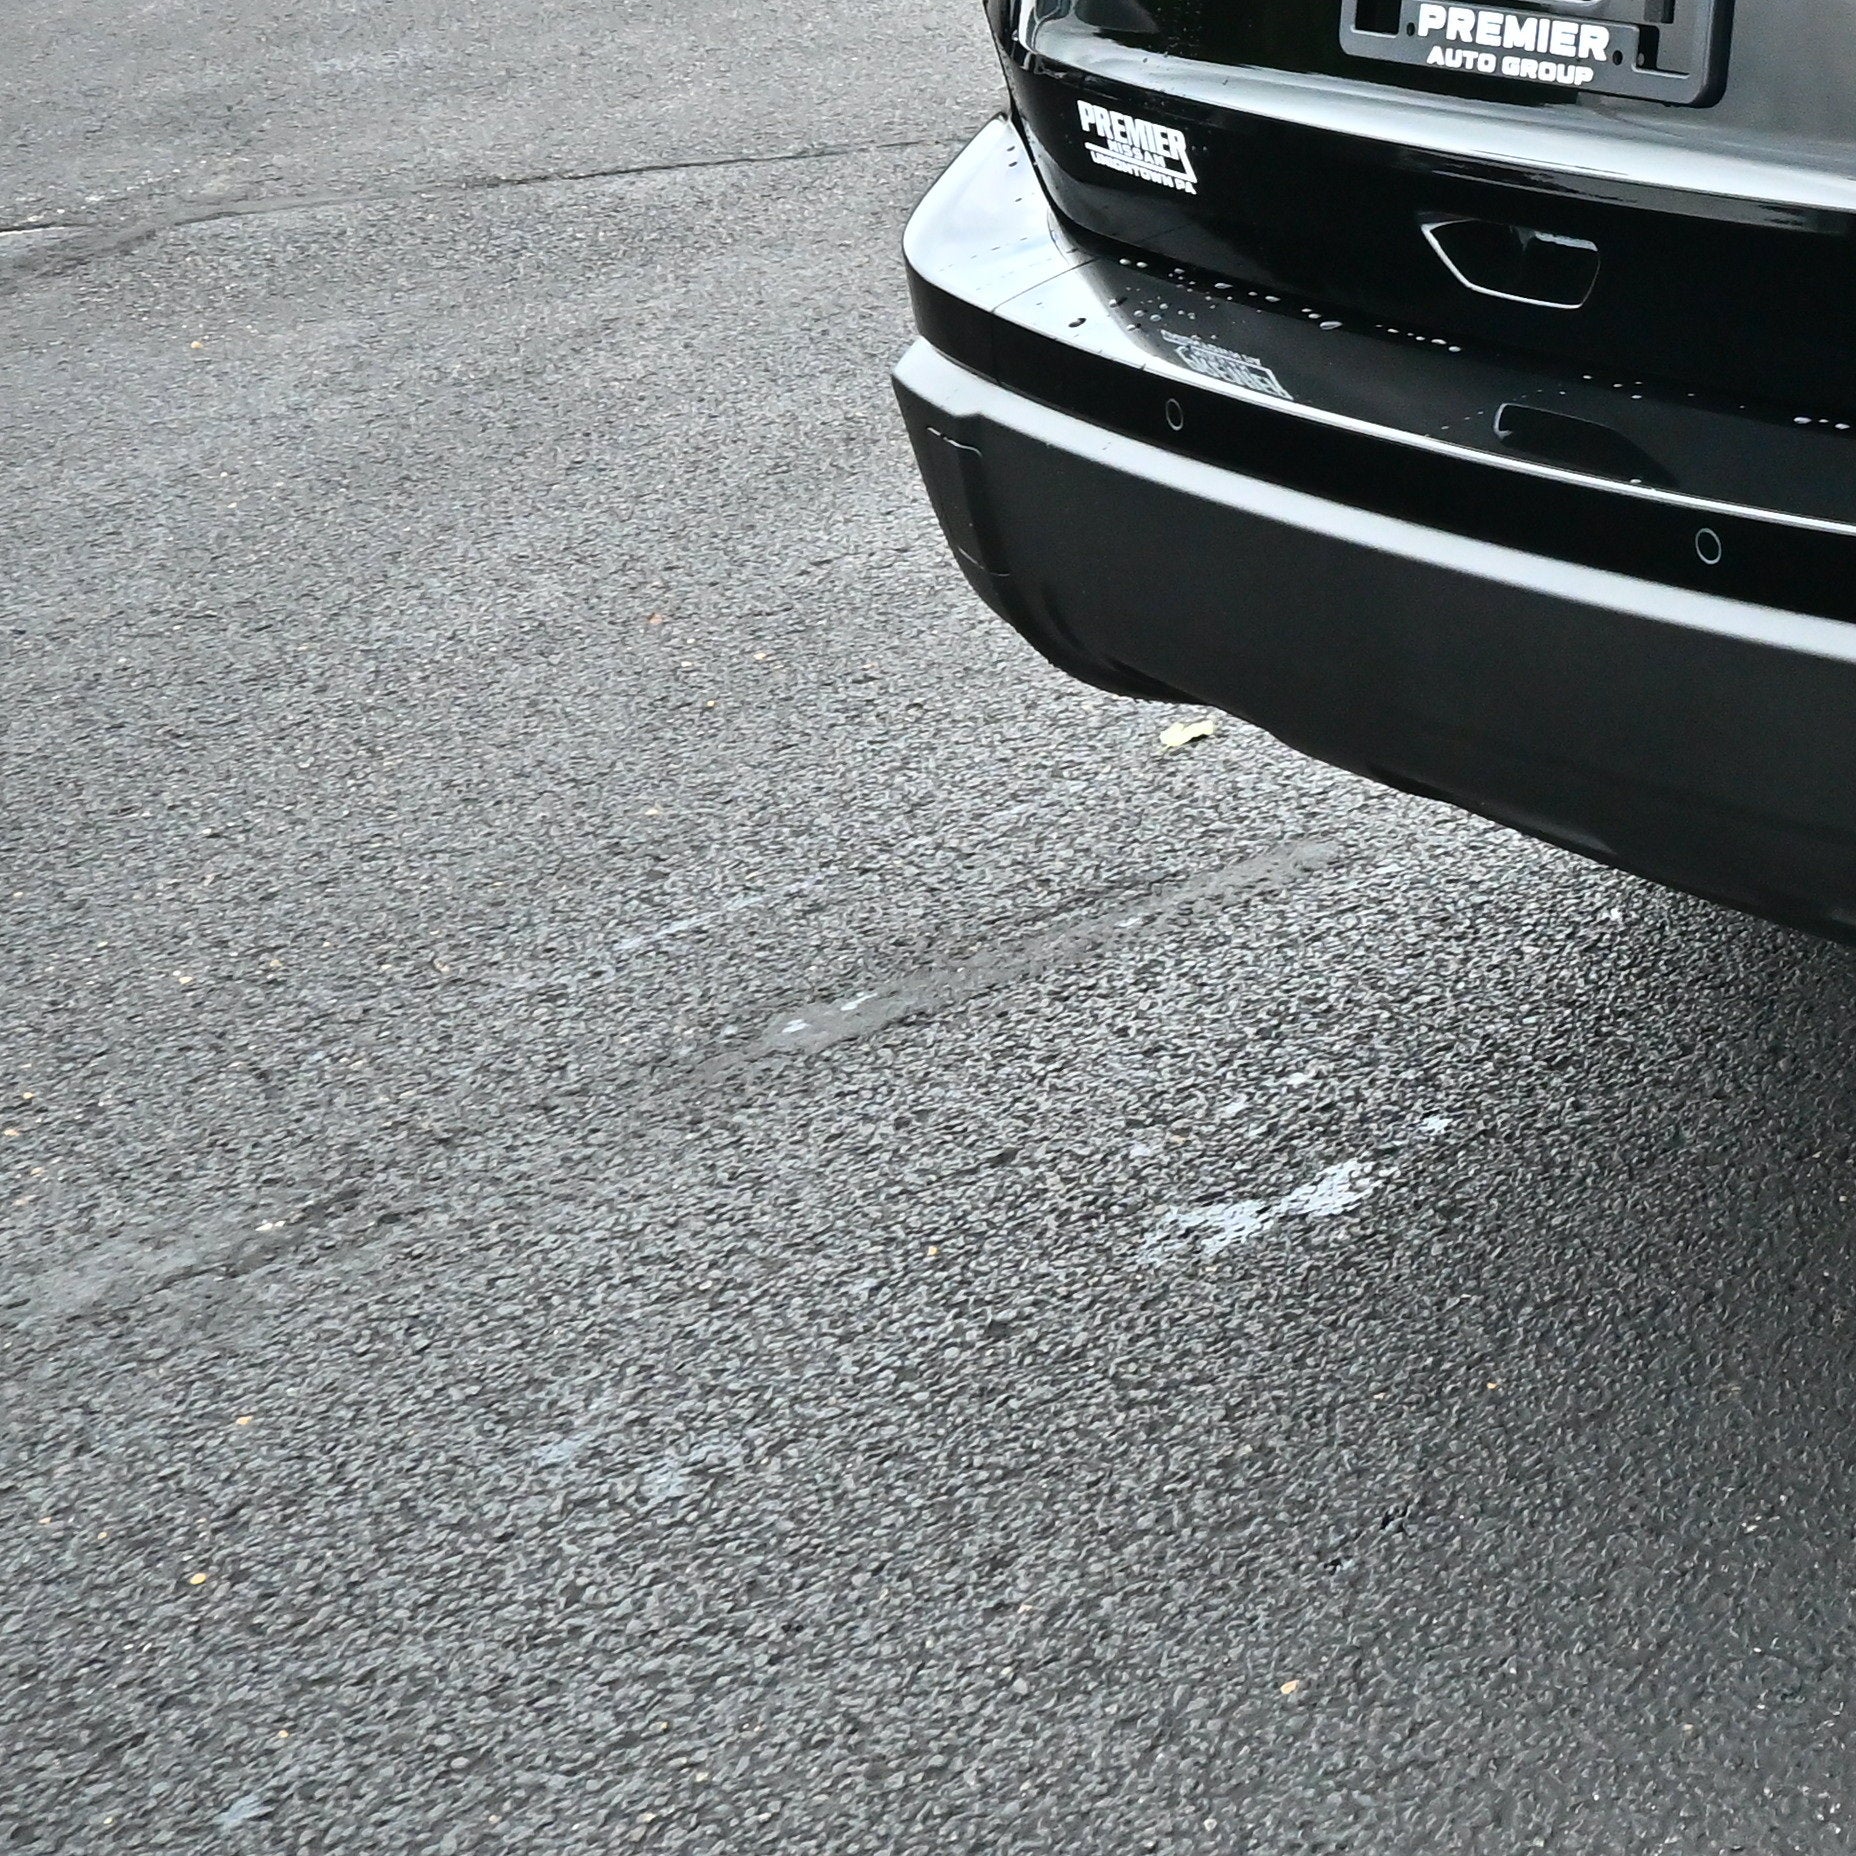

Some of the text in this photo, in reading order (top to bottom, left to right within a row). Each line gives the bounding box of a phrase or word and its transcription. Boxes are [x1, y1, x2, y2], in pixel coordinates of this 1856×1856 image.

[1416, 2, 1610, 63] PREMIER
[1426, 45, 1595, 87] AUTO GROUP
[1076, 99, 1187, 161] PREMIER
[1174, 176, 1198, 196] PA
